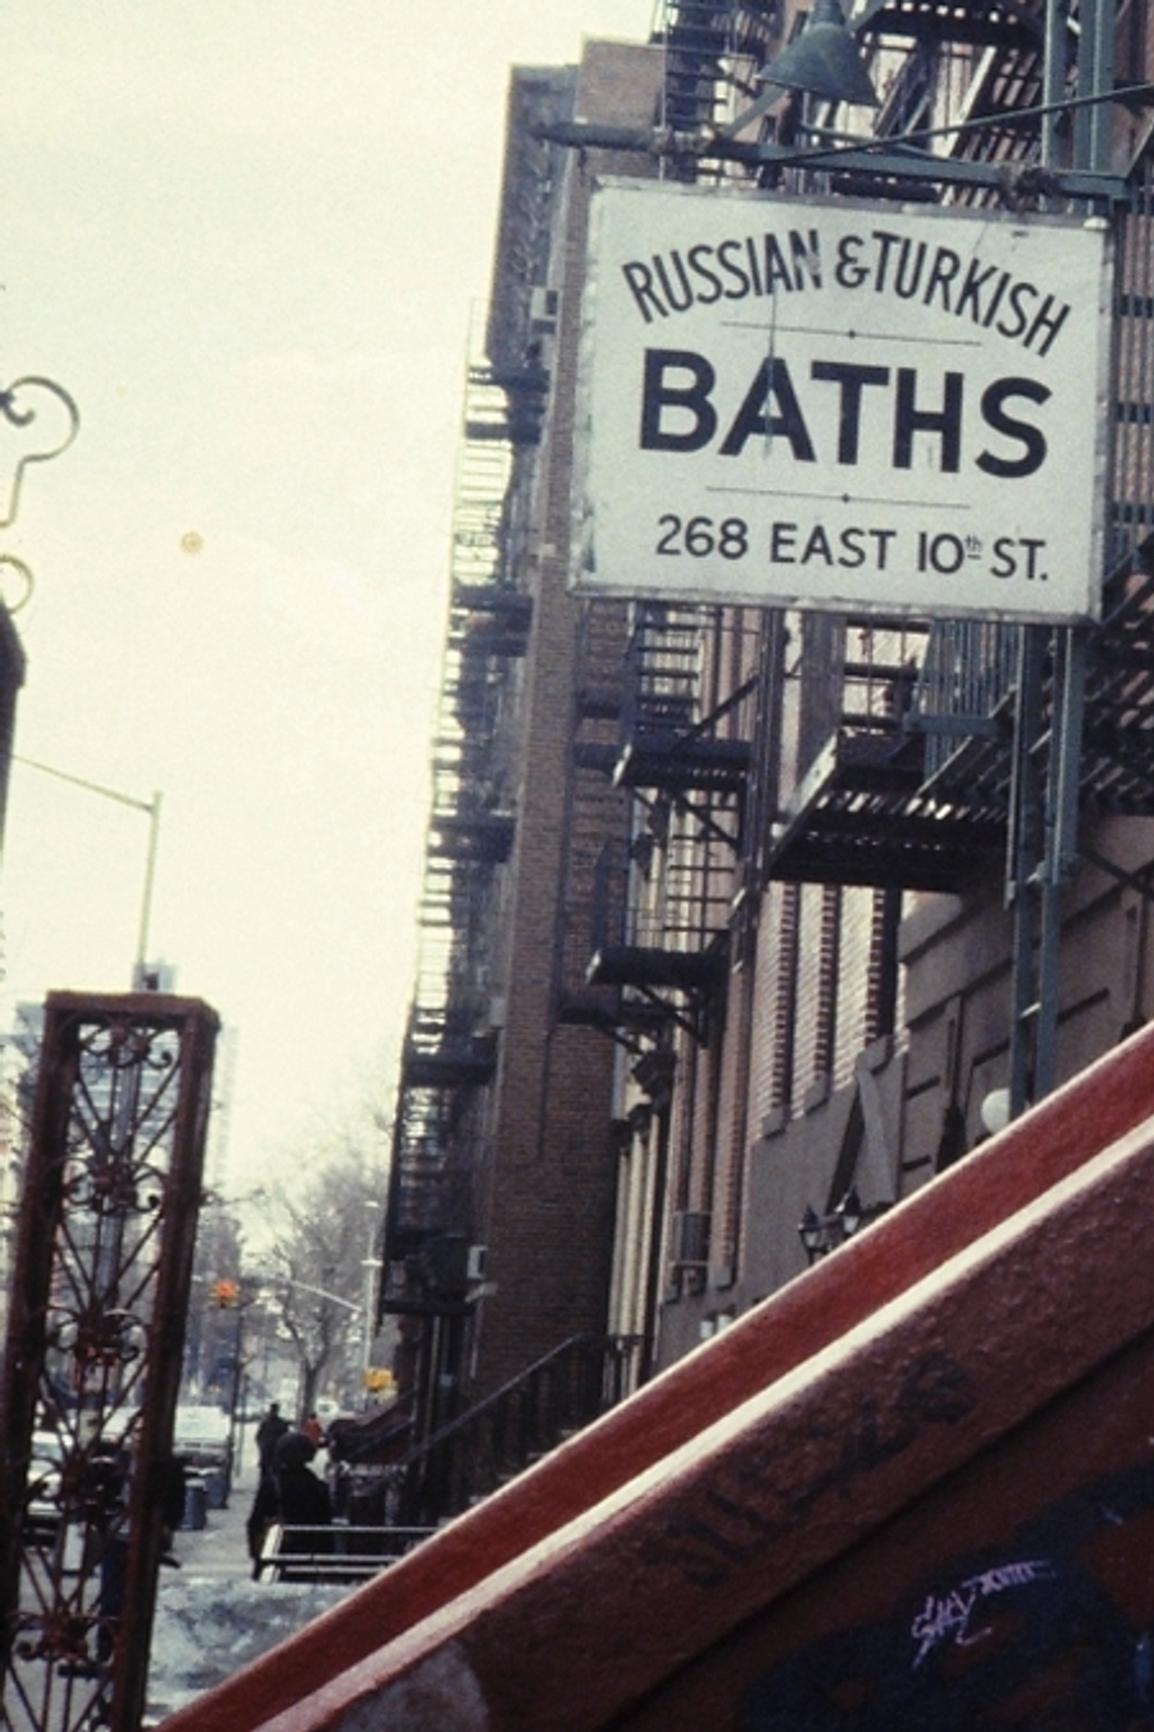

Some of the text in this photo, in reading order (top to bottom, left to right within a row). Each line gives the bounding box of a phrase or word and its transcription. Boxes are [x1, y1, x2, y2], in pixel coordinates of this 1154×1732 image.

[621, 229, 822, 324] RUSSIAN
[639, 347, 1053, 479] BATHS
[656, 514, 749, 560] 268
[770, 523, 896, 571] EAST
[990, 537, 1049, 581] ST.
